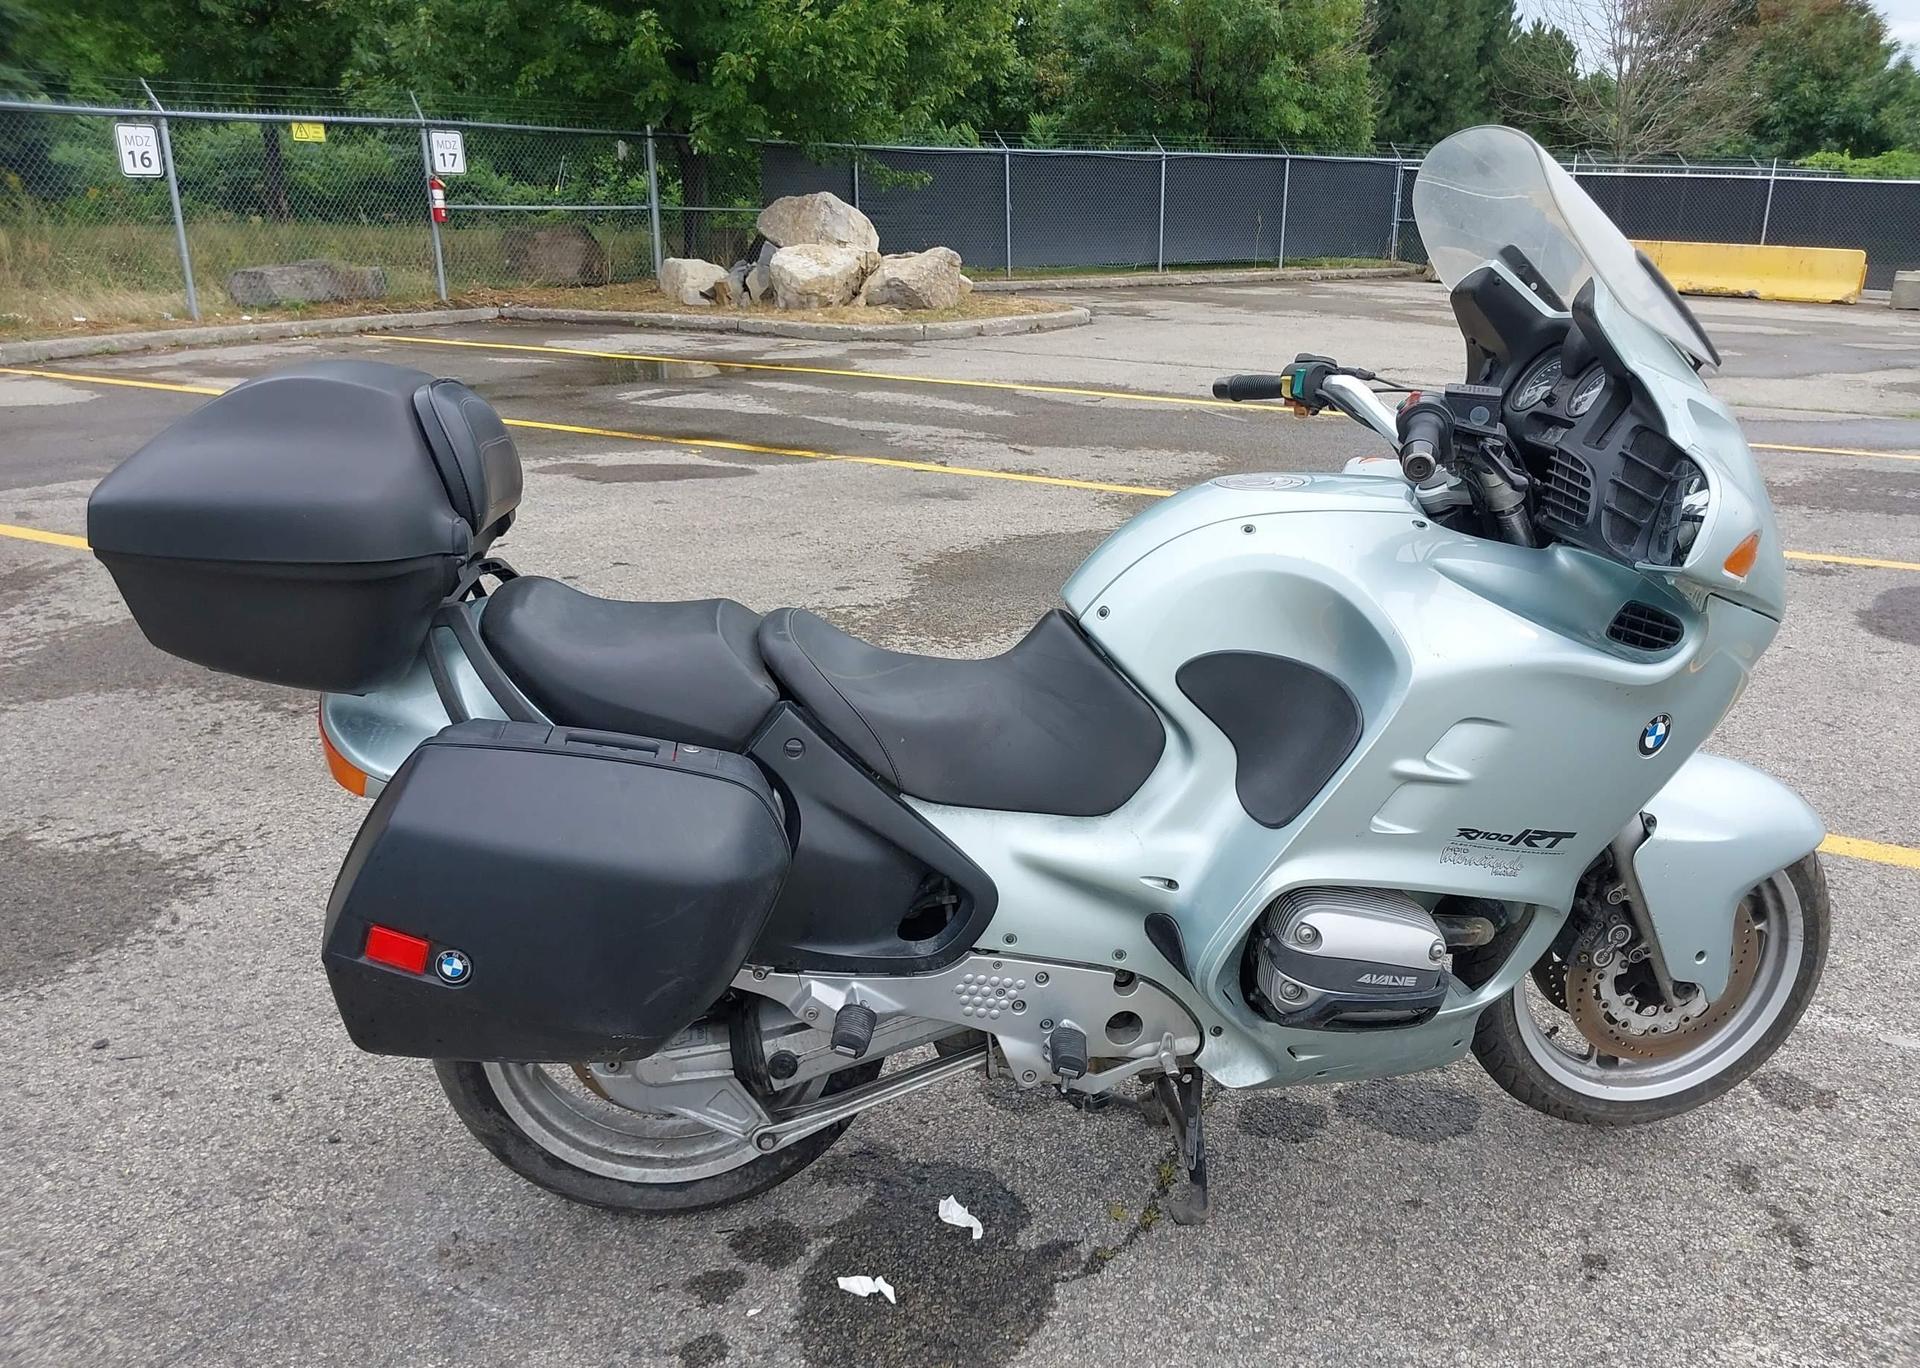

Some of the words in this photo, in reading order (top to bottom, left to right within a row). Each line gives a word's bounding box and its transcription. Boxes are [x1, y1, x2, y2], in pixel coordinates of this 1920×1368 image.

[124, 135, 152, 147] MDZ
[436, 139, 458, 150] MDZ
[128, 150, 153, 168] 16
[439, 152, 457, 168] 17
[441, 952, 469, 966] BMW
[1356, 973, 1418, 987] 4VALVE
